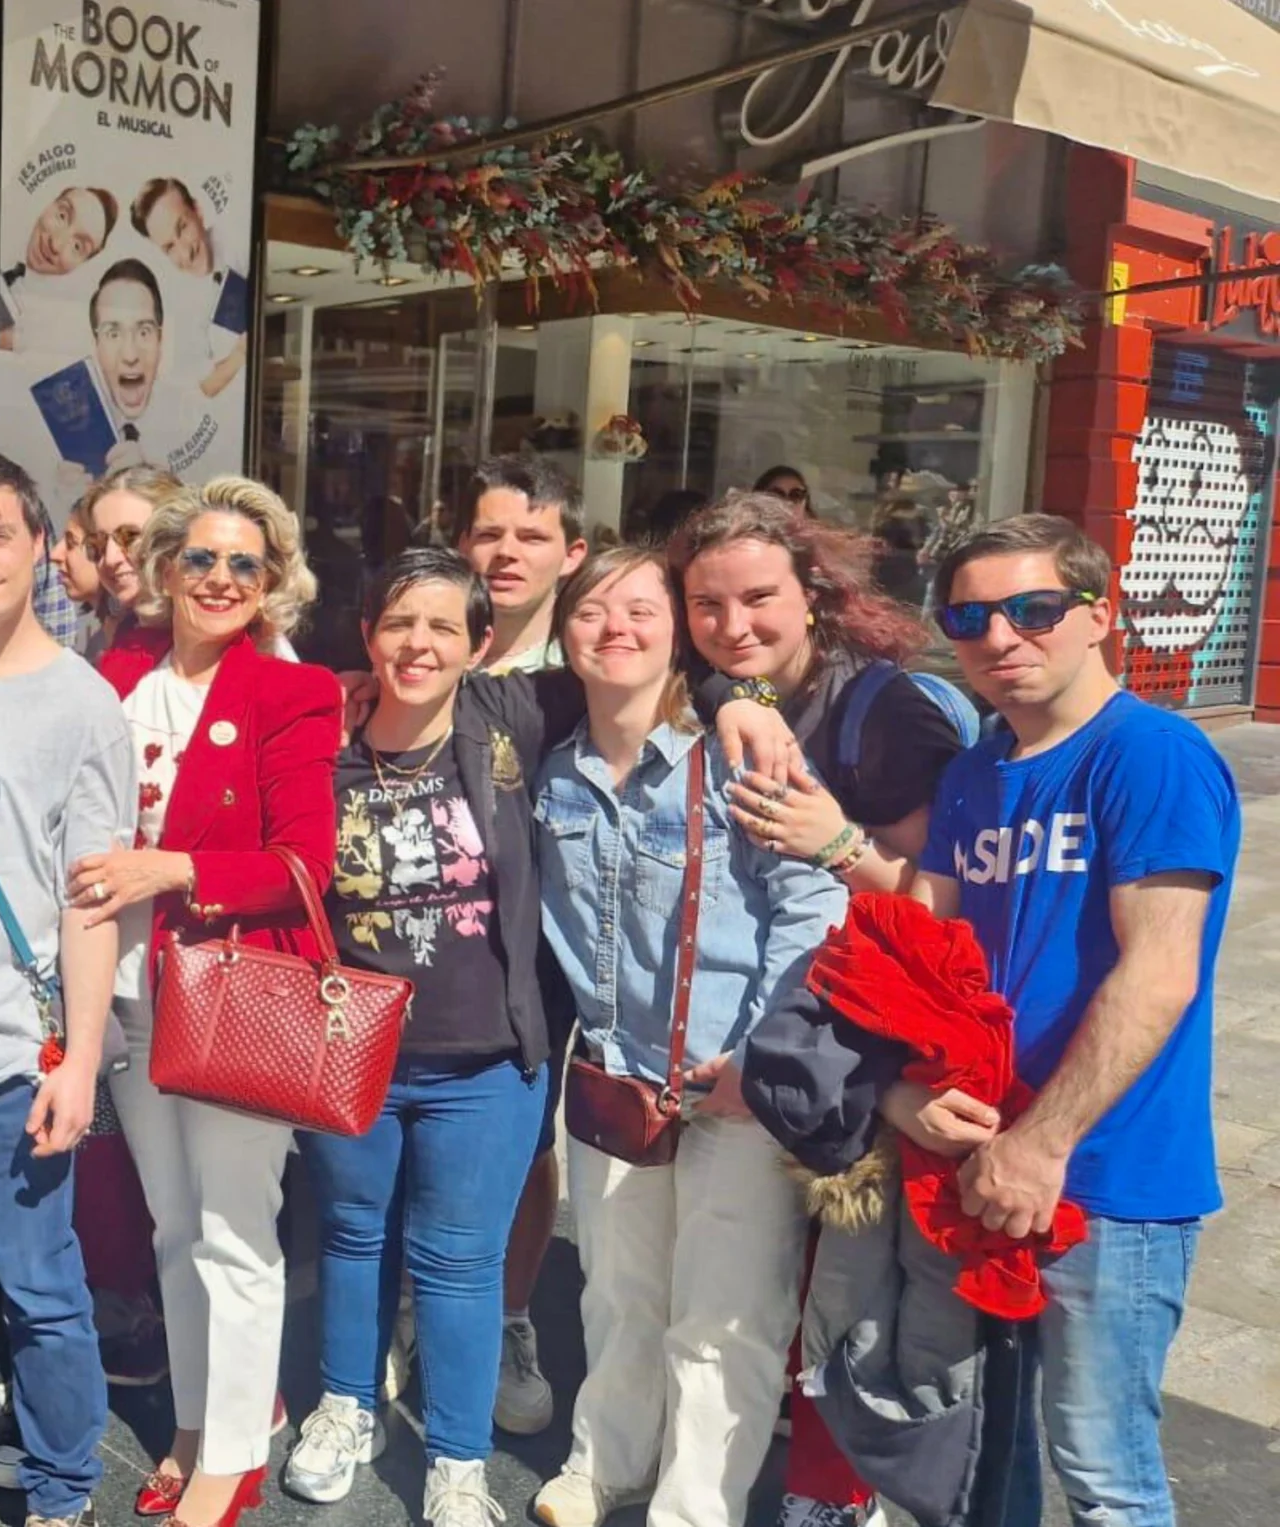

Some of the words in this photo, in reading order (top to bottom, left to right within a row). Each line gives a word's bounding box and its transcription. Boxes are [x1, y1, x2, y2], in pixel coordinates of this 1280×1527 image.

[53, 22, 76, 41] THE
[82, 0, 201, 70] BOOK
[204, 58, 220, 73] OF
[30, 37, 233, 128] MORMON
[97, 111, 111, 128] EL
[117, 115, 174, 139] MUSICAL
[39, 143, 76, 167] ALGO
